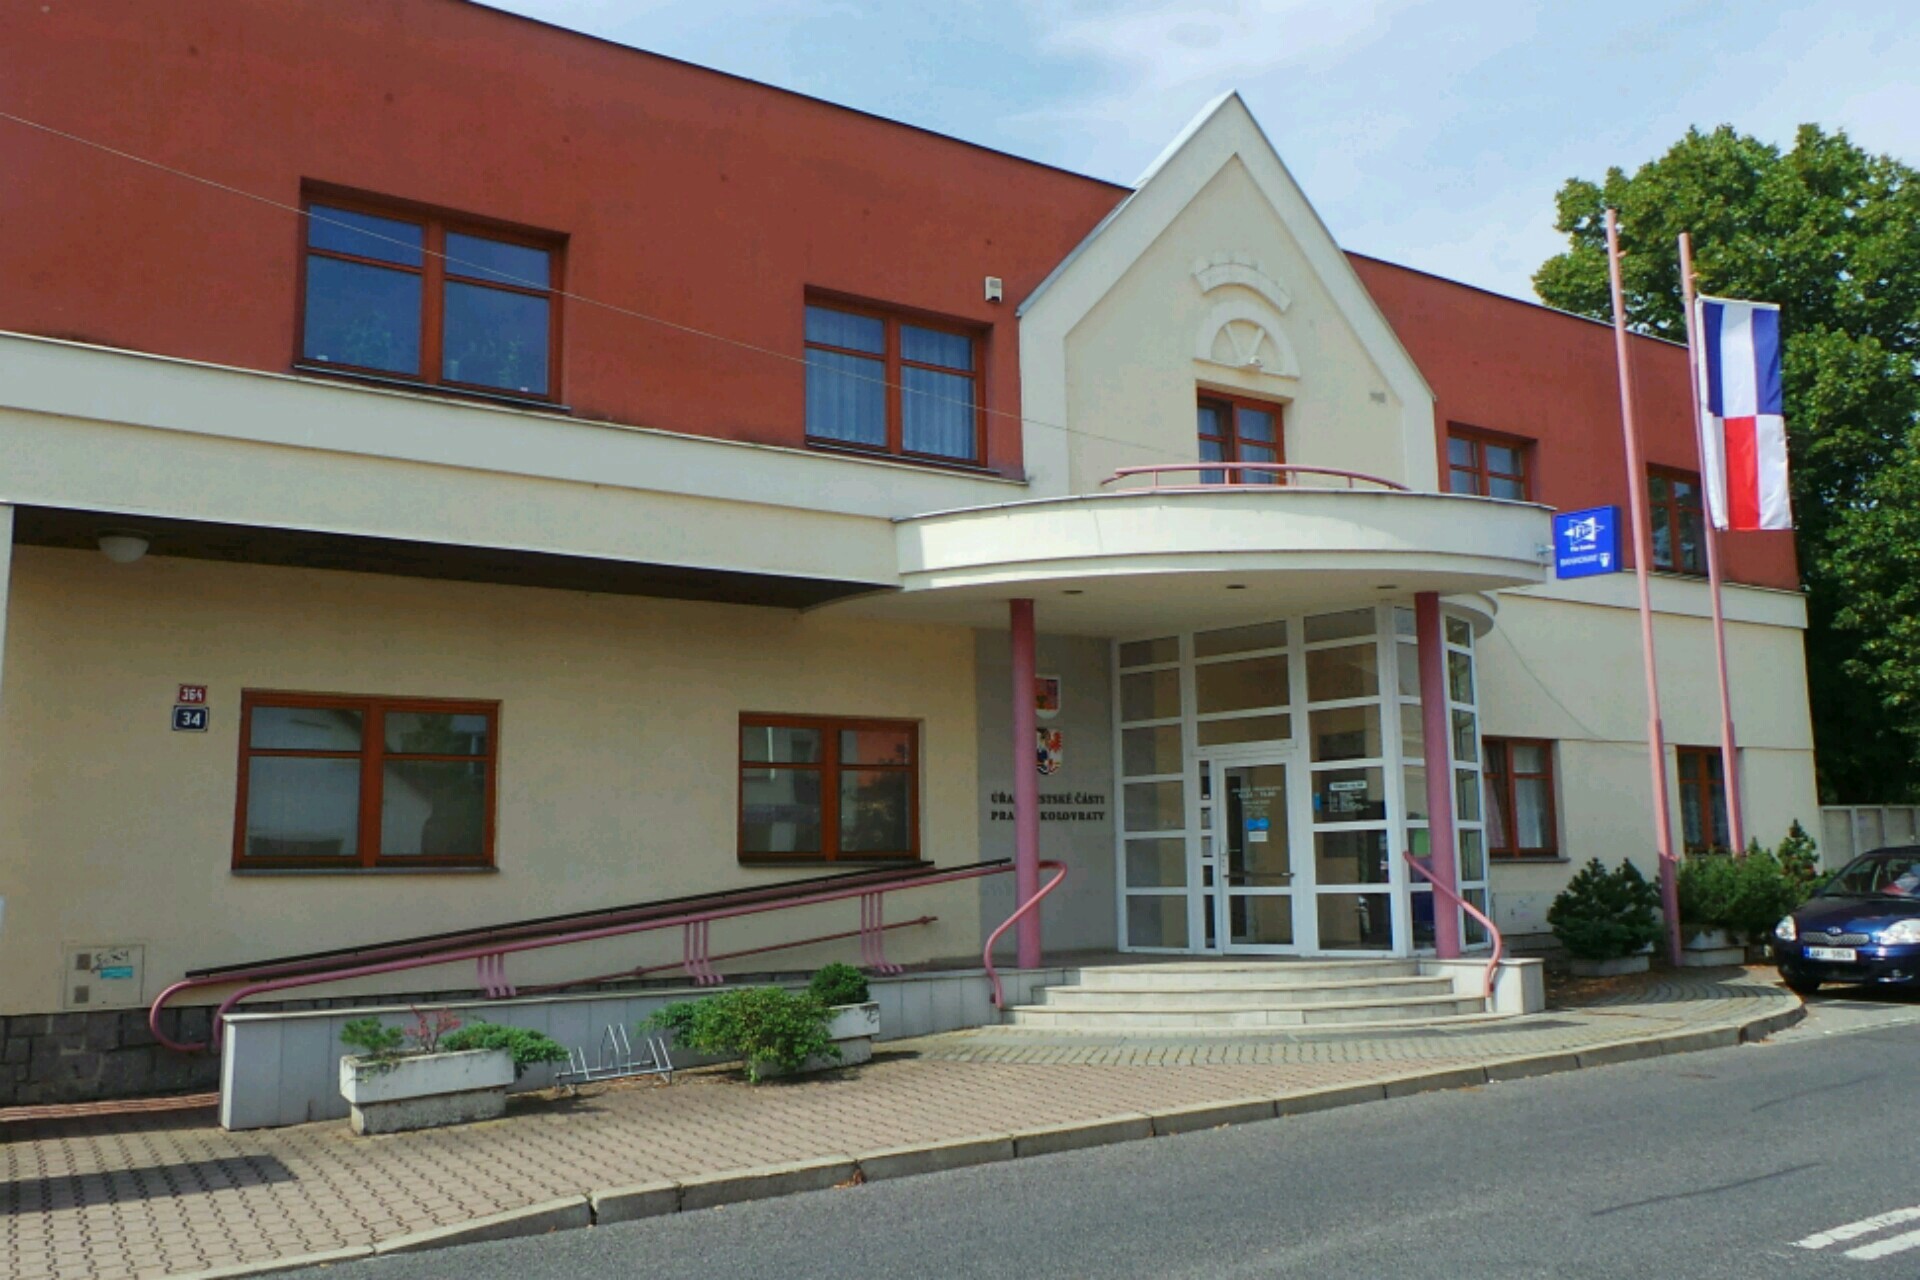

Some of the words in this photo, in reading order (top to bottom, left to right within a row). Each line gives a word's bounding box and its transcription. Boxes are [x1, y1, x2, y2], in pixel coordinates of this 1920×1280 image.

[182, 711, 200, 726] 34
[991, 791, 1015, 804] ÚŘA
[1038, 791, 1073, 804] STSKÉ
[991, 811, 1015, 821] PRA
[1040, 811, 1105, 821] KOLOVRATY
